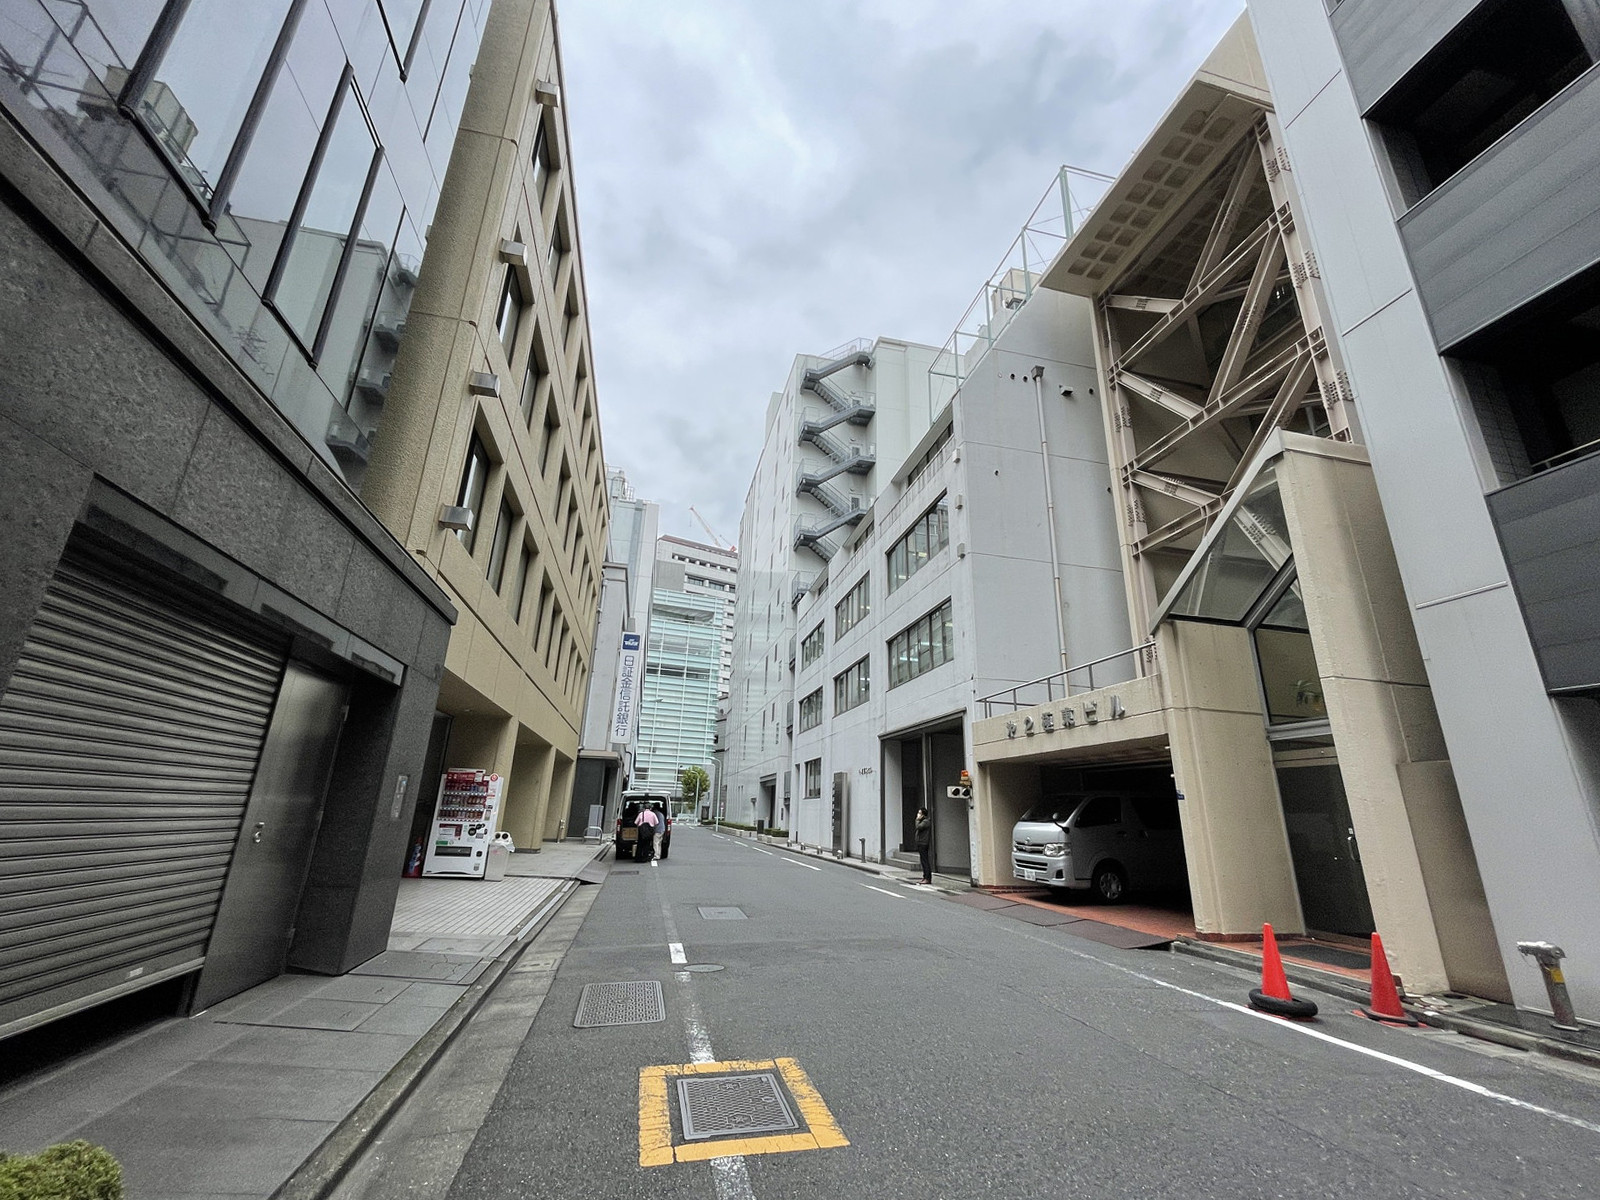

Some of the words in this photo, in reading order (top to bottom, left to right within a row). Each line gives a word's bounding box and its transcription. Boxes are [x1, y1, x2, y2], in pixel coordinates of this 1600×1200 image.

[615, 655, 635, 736] 日証金信託銀行
